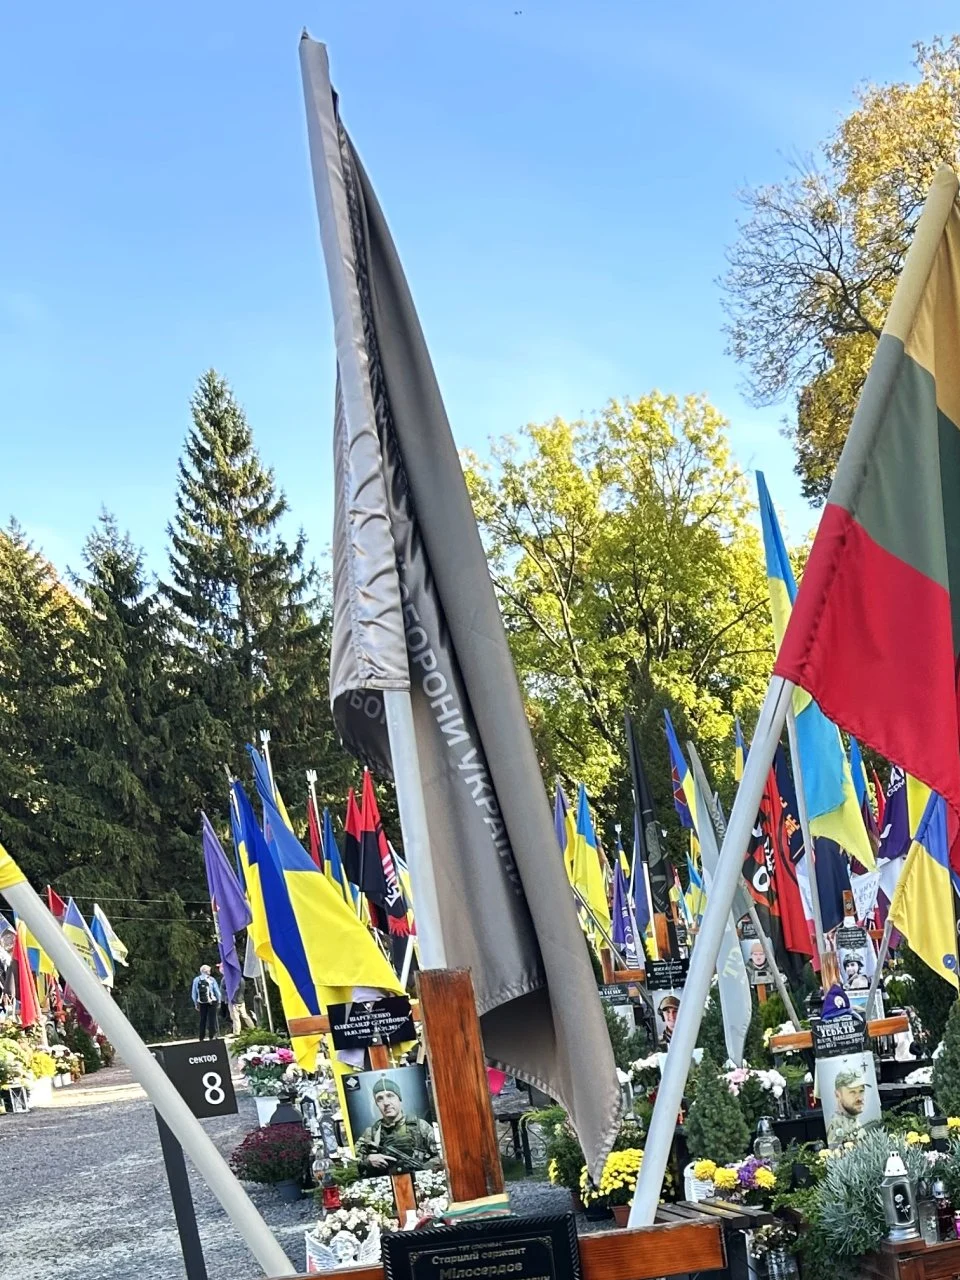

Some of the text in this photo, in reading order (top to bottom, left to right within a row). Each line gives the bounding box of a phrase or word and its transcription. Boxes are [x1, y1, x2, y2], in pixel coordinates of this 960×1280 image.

[189, 1054, 217, 1064] сектор
[202, 1071, 225, 1105] 8
[432, 1247, 526, 1265] Старший сержант
[439, 1261, 523, 1280] Мілосердов
